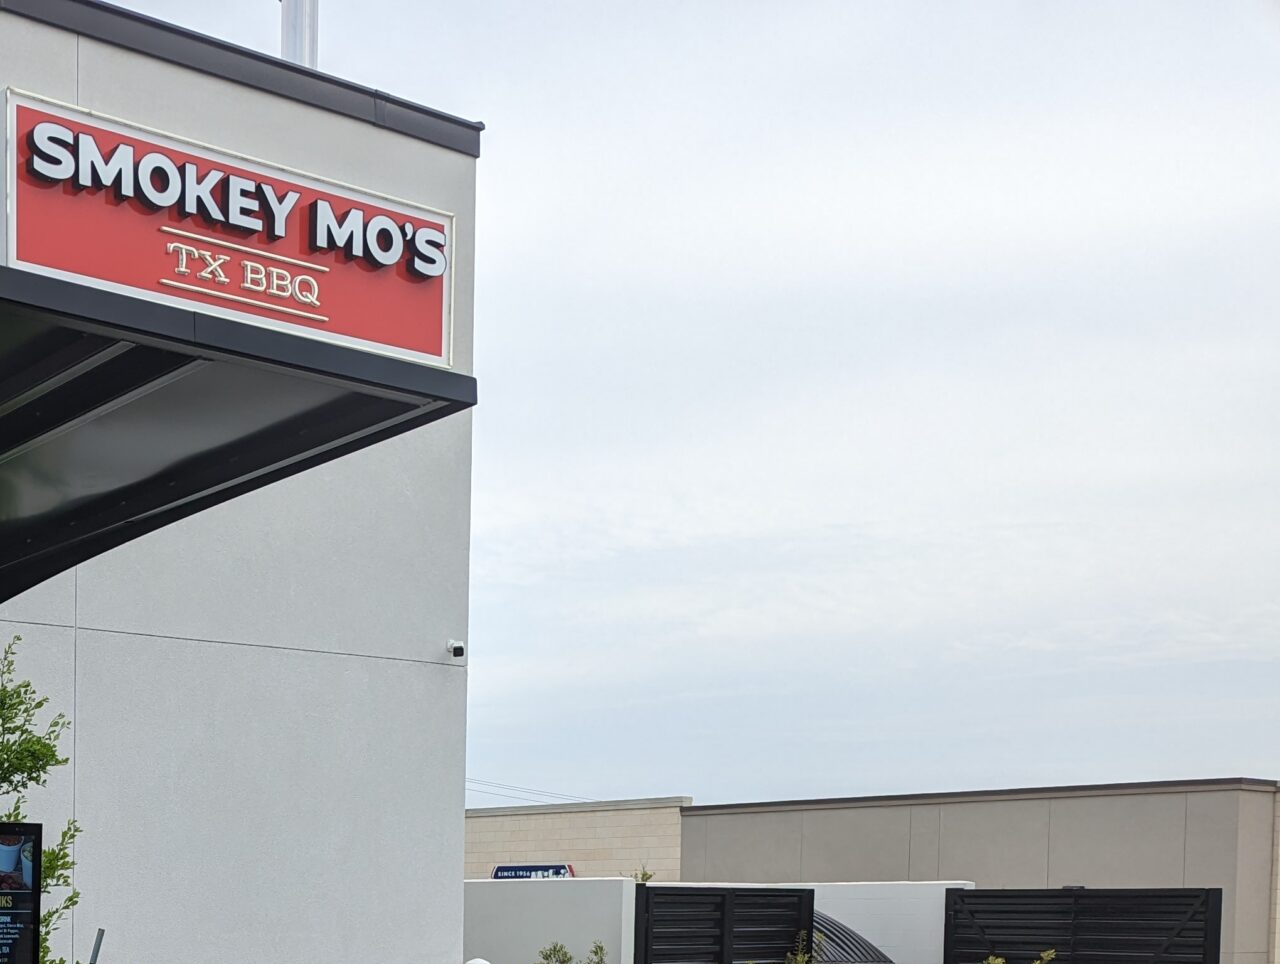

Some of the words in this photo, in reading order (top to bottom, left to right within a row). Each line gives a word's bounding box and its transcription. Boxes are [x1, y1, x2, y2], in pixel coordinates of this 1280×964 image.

[29, 121, 300, 238] SMOKEY
[315, 199, 447, 277] MO'S
[167, 242, 230, 284] TX
[240, 260, 320, 307] BBQ
